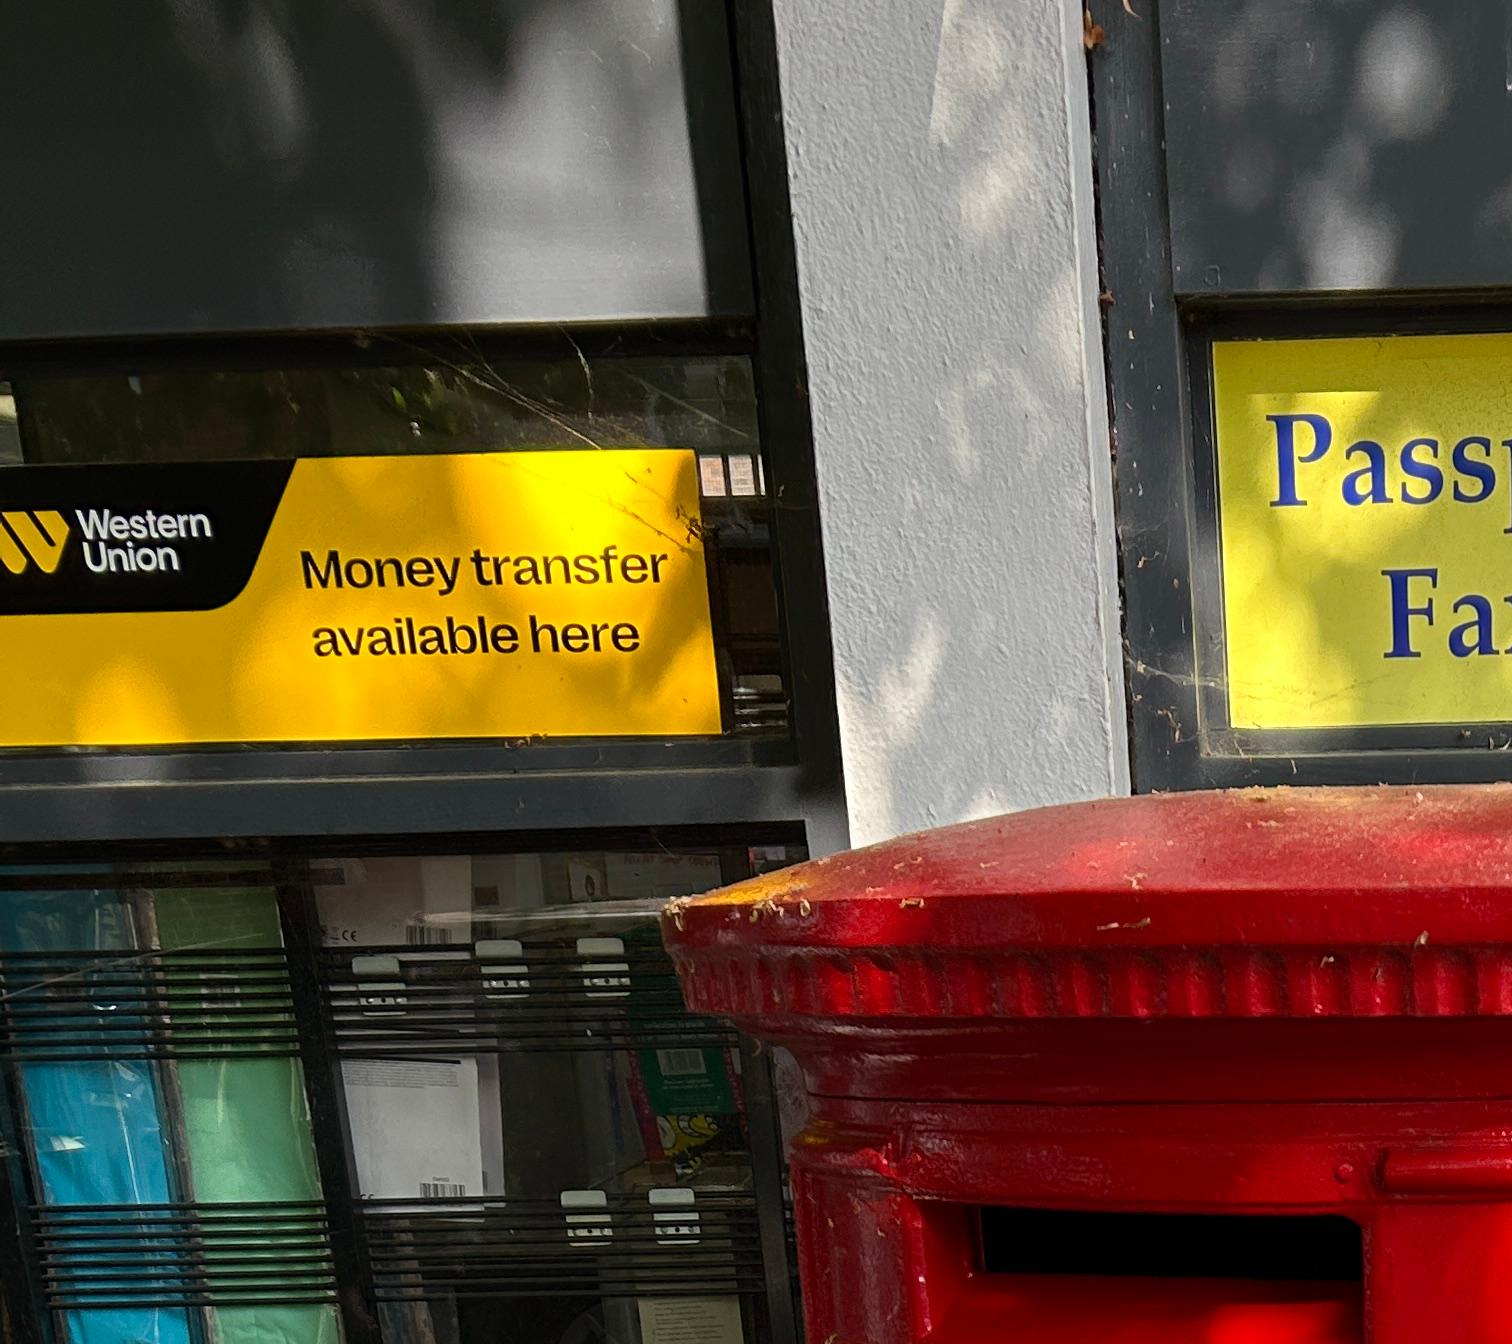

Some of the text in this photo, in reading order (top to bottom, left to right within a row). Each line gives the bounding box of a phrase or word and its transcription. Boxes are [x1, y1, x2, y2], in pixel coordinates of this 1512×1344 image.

[75, 509, 212, 541] Western
[83, 541, 180, 573] Union
[301, 545, 669, 595] Money transfer
[313, 615, 640, 657] available here
